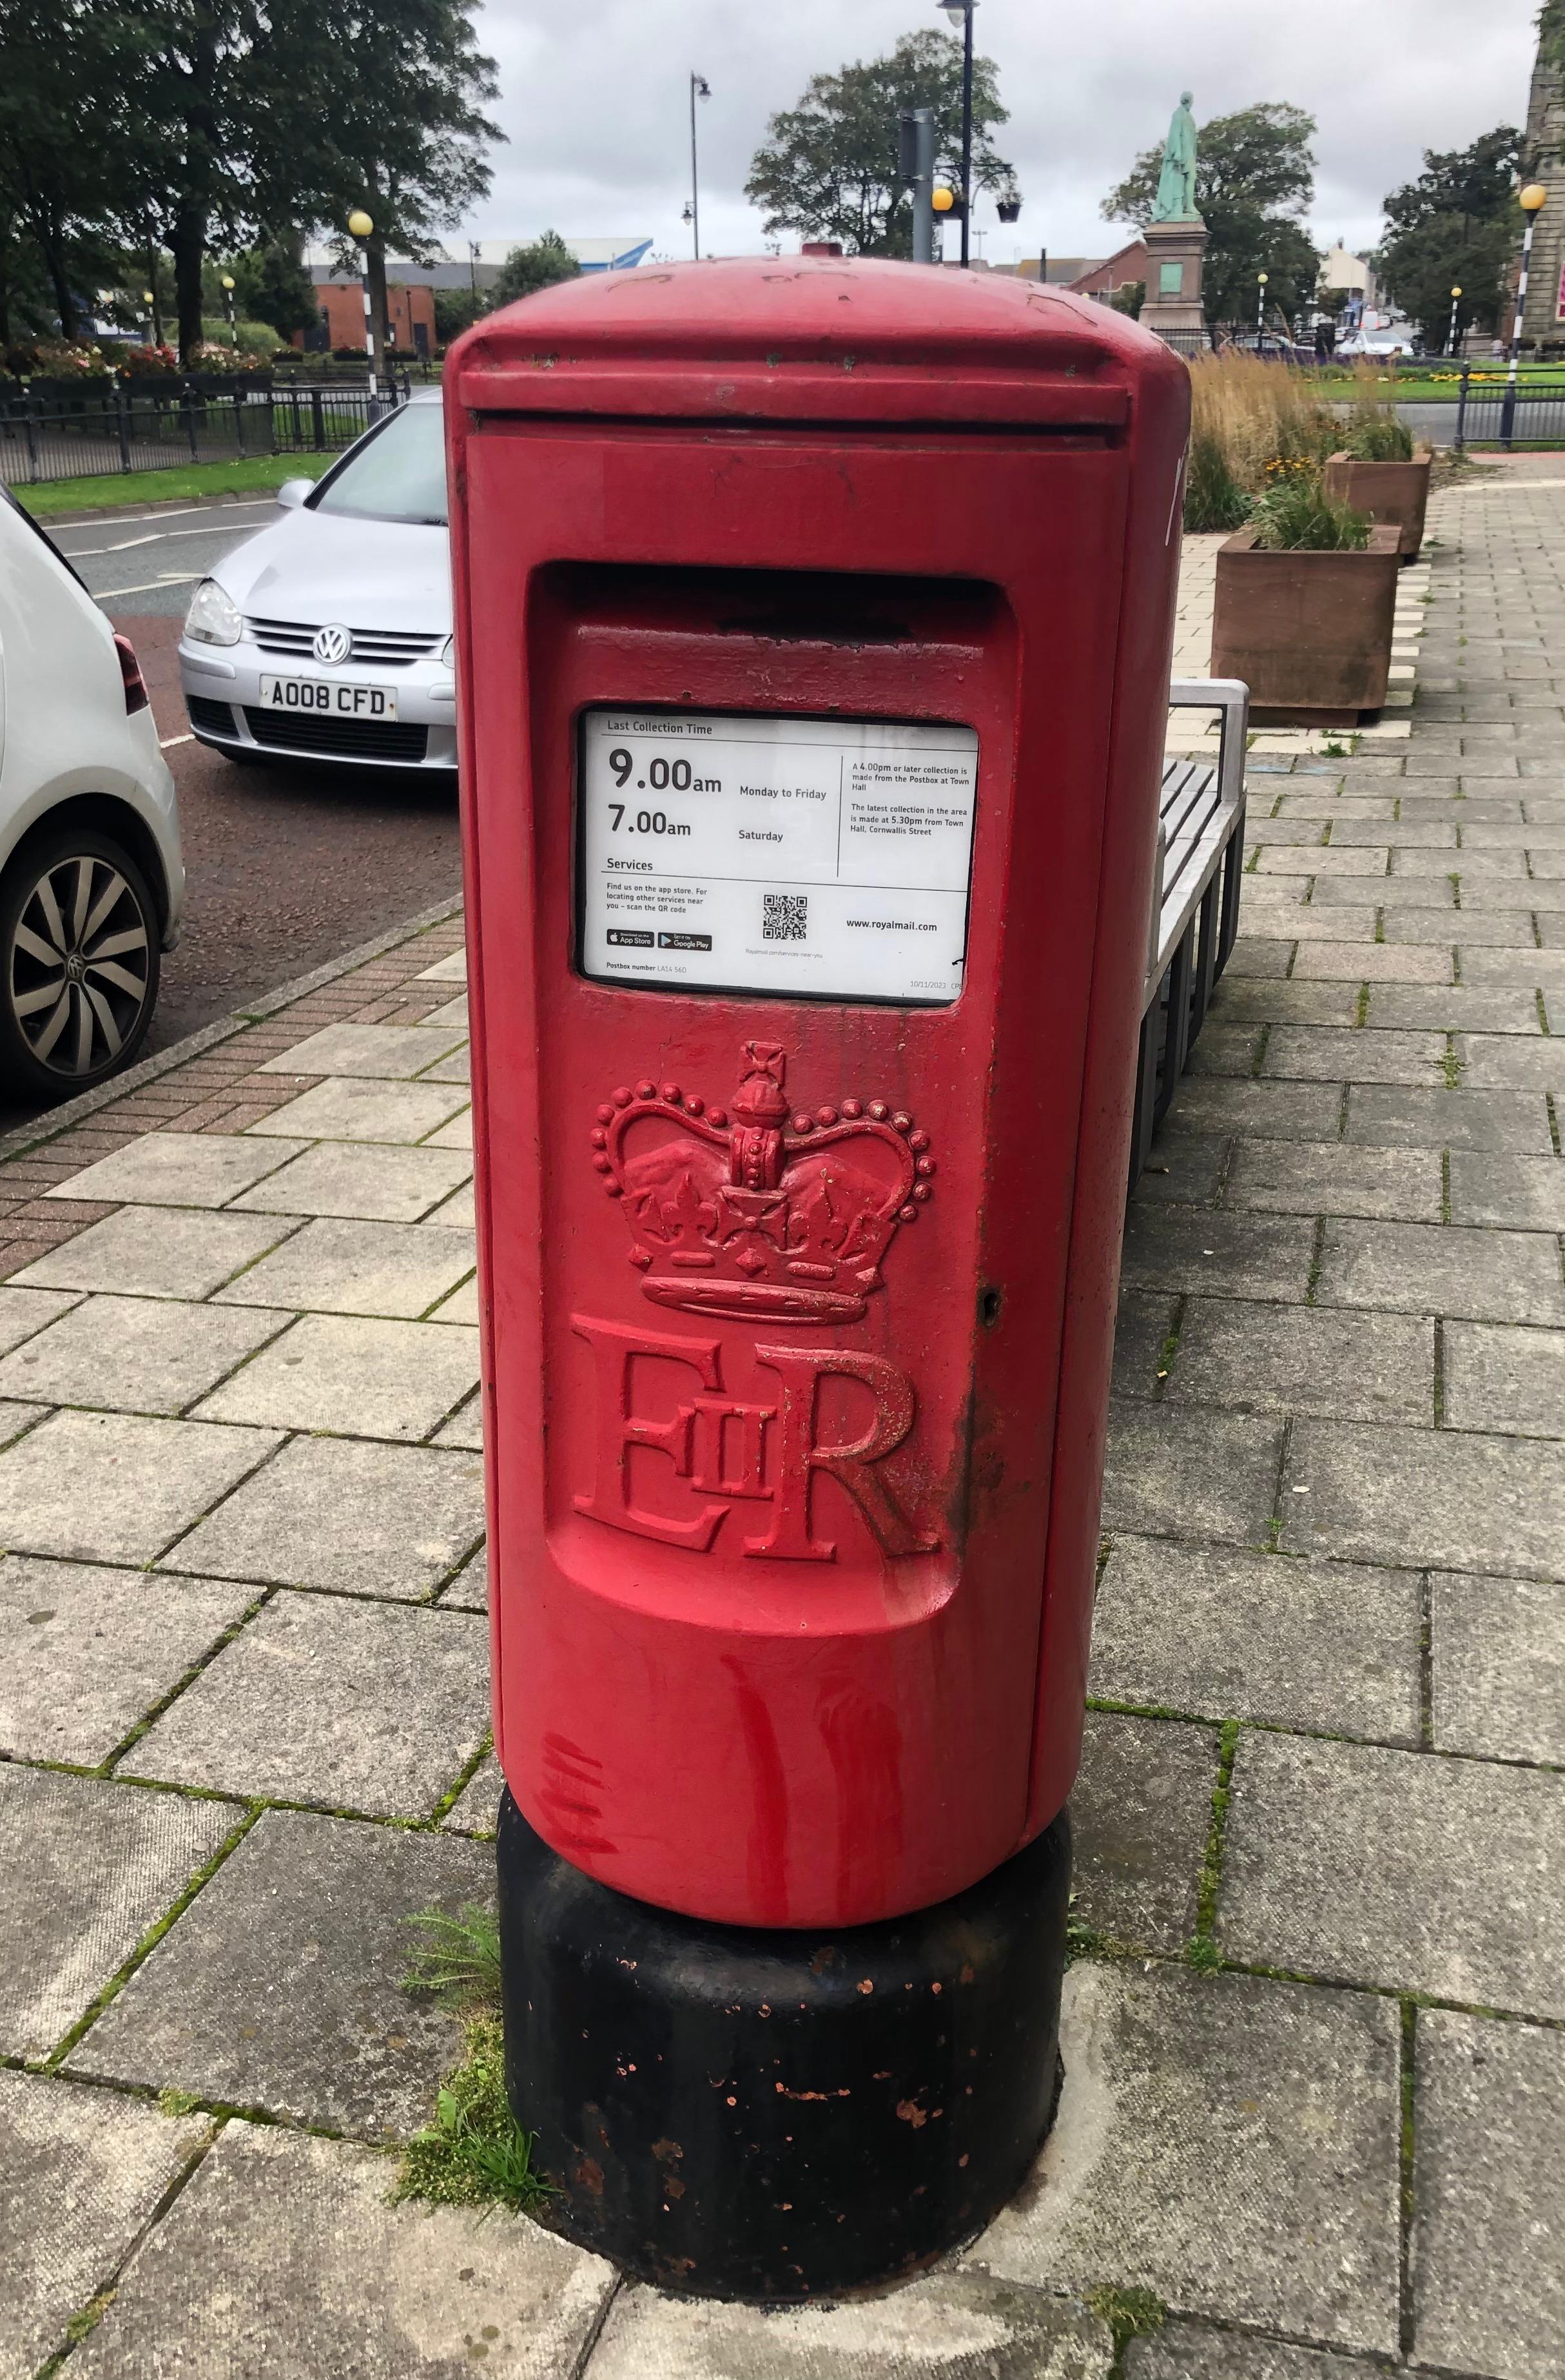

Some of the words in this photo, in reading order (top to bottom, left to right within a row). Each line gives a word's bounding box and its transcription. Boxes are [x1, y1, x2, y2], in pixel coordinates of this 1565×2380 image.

[337, 687, 385, 715] CFD
[607, 720, 630, 730] Last
[633, 721, 683, 734] Collection
[686, 723, 712, 735] Time
[860, 762, 891, 772] 4.00pm
[923, 766, 958, 774] collection
[909, 775, 938, 784] Postbox
[739, 786, 779, 799] Monday
[782, 788, 792, 797] to
[795, 788, 827, 801] Friday
[867, 804, 888, 812] latest
[889, 805, 924, 814] collection
[891, 815, 922, 826] 5.30pm
[945, 819, 964, 827] Town
[739, 830, 784, 843] Saturday
[850, 825, 867, 834] Hall,
[869, 826, 907, 834] Cornwallis
[909, 828, 932, 836] Street
[607, 858, 653, 870] Services
[607, 893, 634, 902] locating
[846, 919, 937, 932] www.royalmail.com
[620, 936, 634, 944] App
[674, 939, 695, 948] Google
[696, 941, 709, 950] Play
[910, 980, 946, 989] 10/11/2023
